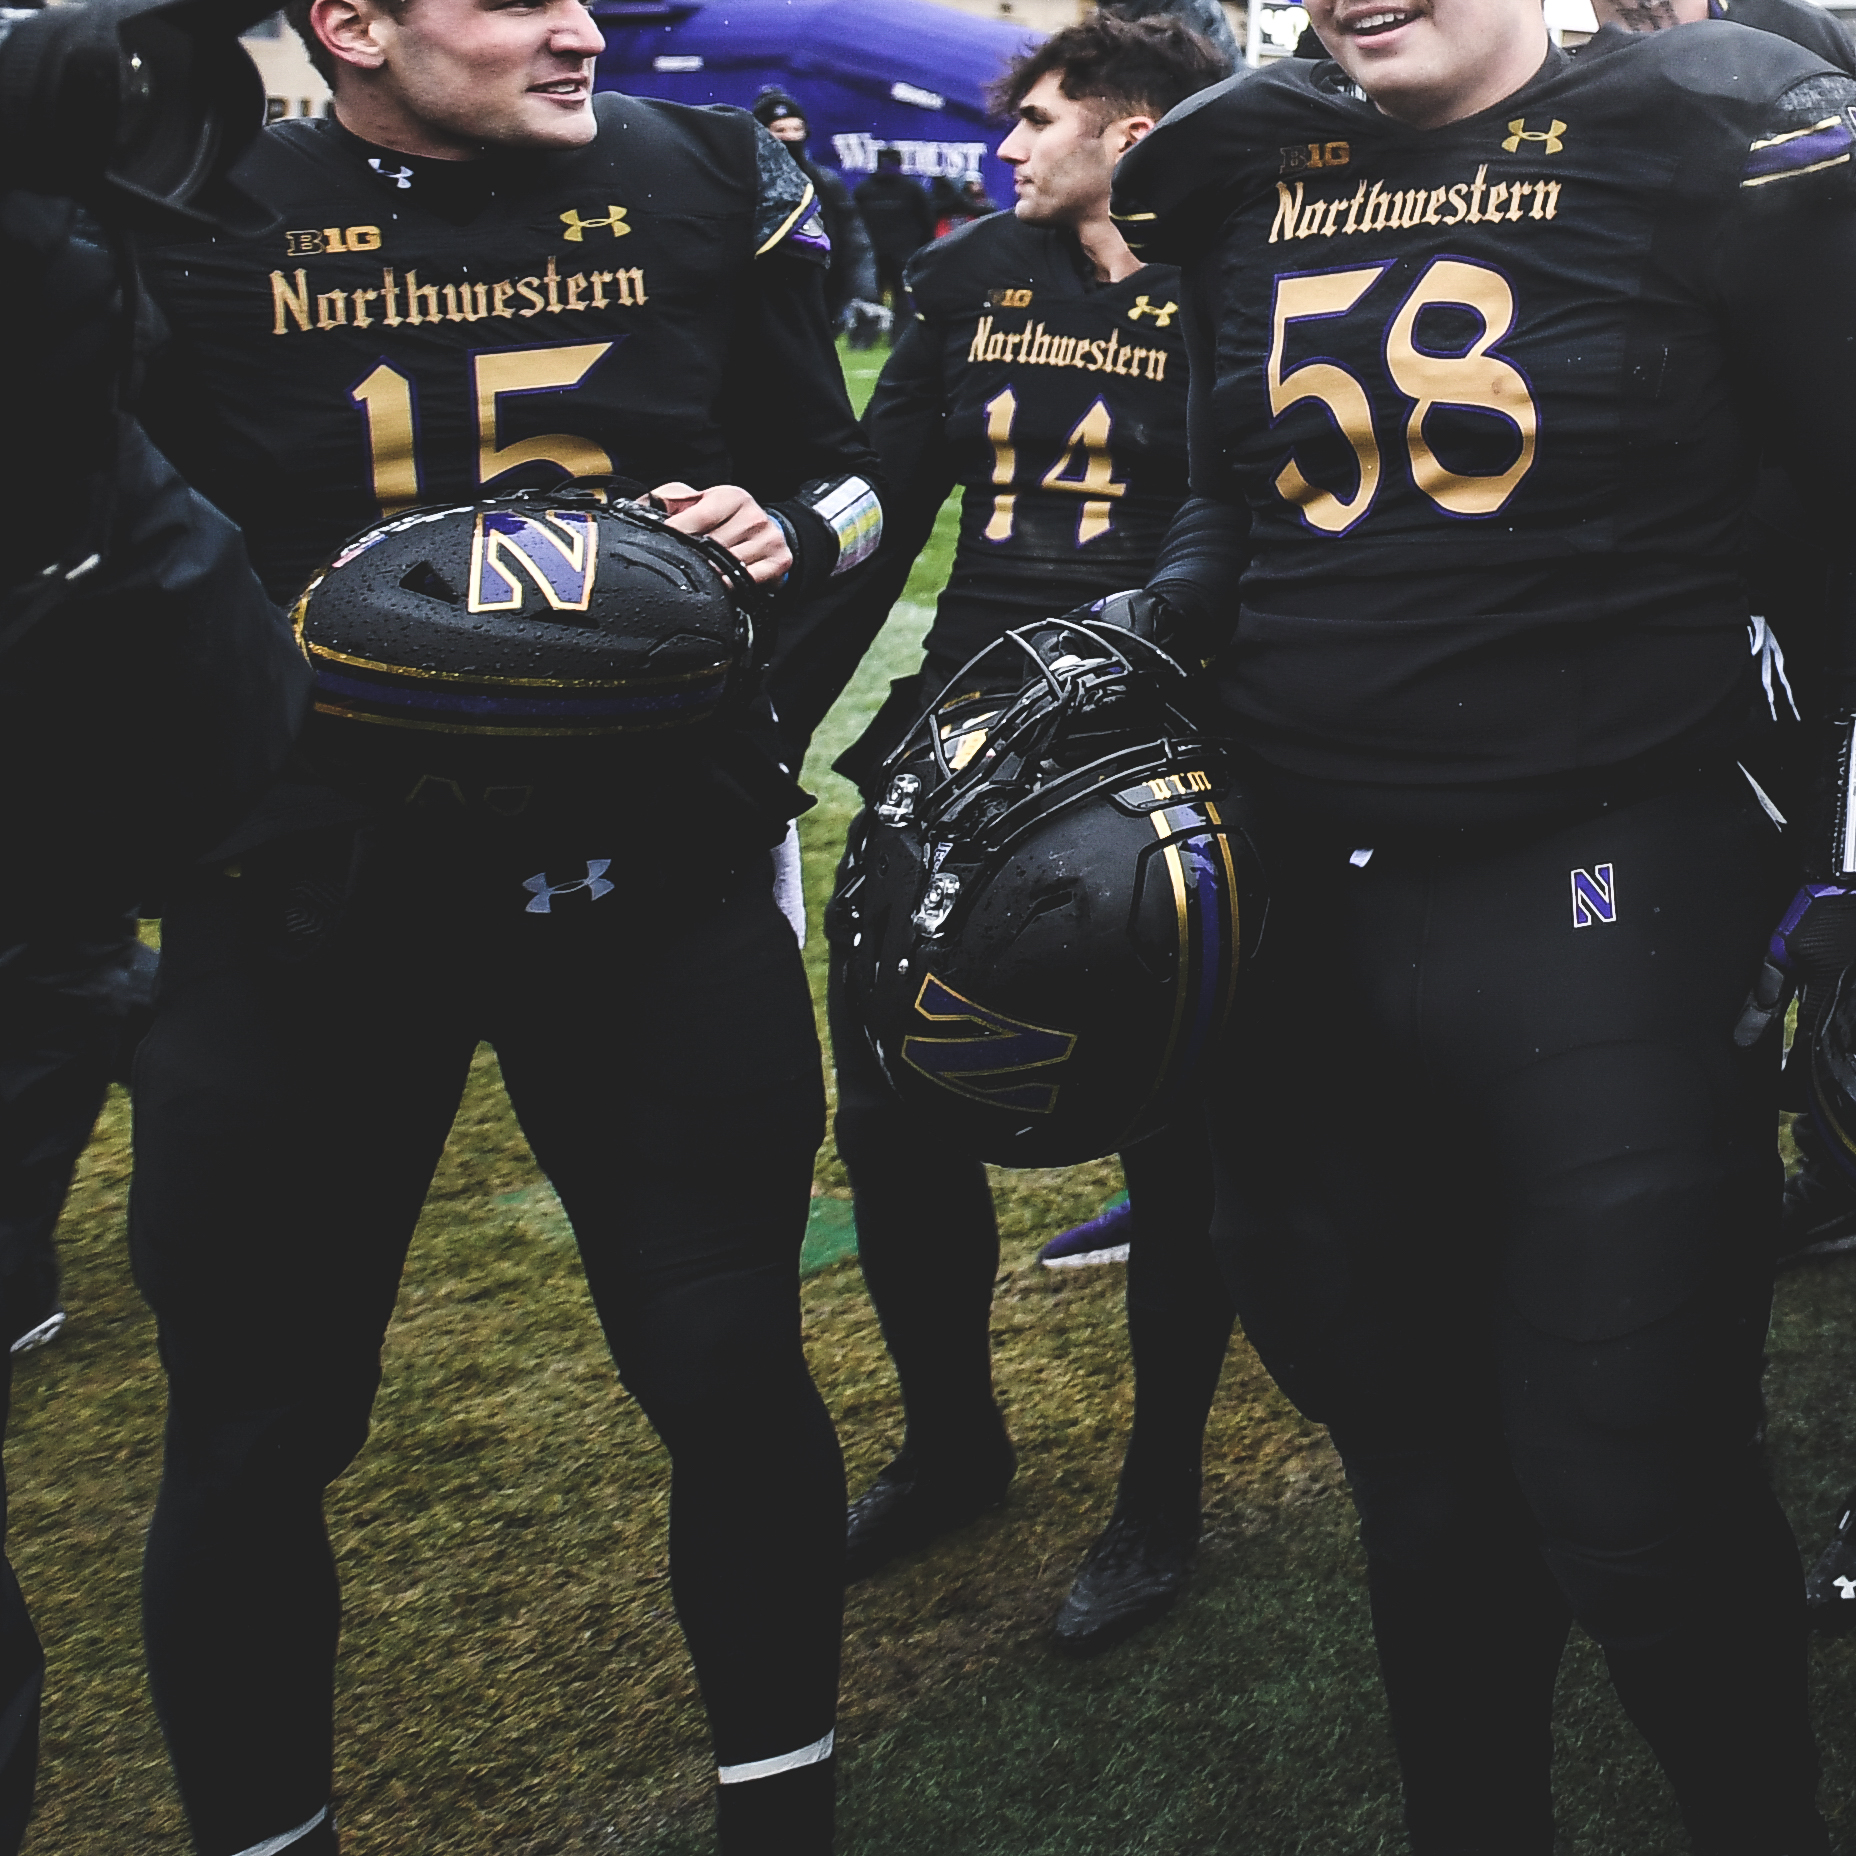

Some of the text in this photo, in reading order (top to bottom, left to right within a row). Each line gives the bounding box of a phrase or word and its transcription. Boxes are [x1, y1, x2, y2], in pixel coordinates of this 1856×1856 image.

[1280, 141, 1350, 174] B1G
[286, 226, 382, 256] B1G
[1267, 164, 1563, 244] Northwestern
[271, 255, 649, 335] Northwestern
[967, 315, 1168, 382] Northwestern
[345, 334, 630, 517] 15
[1264, 253, 1543, 538] 58
[983, 385, 1129, 545] 14
[467, 509, 599, 614] N
[1571, 863, 1617, 928] N
[900, 973, 1078, 1114] N
